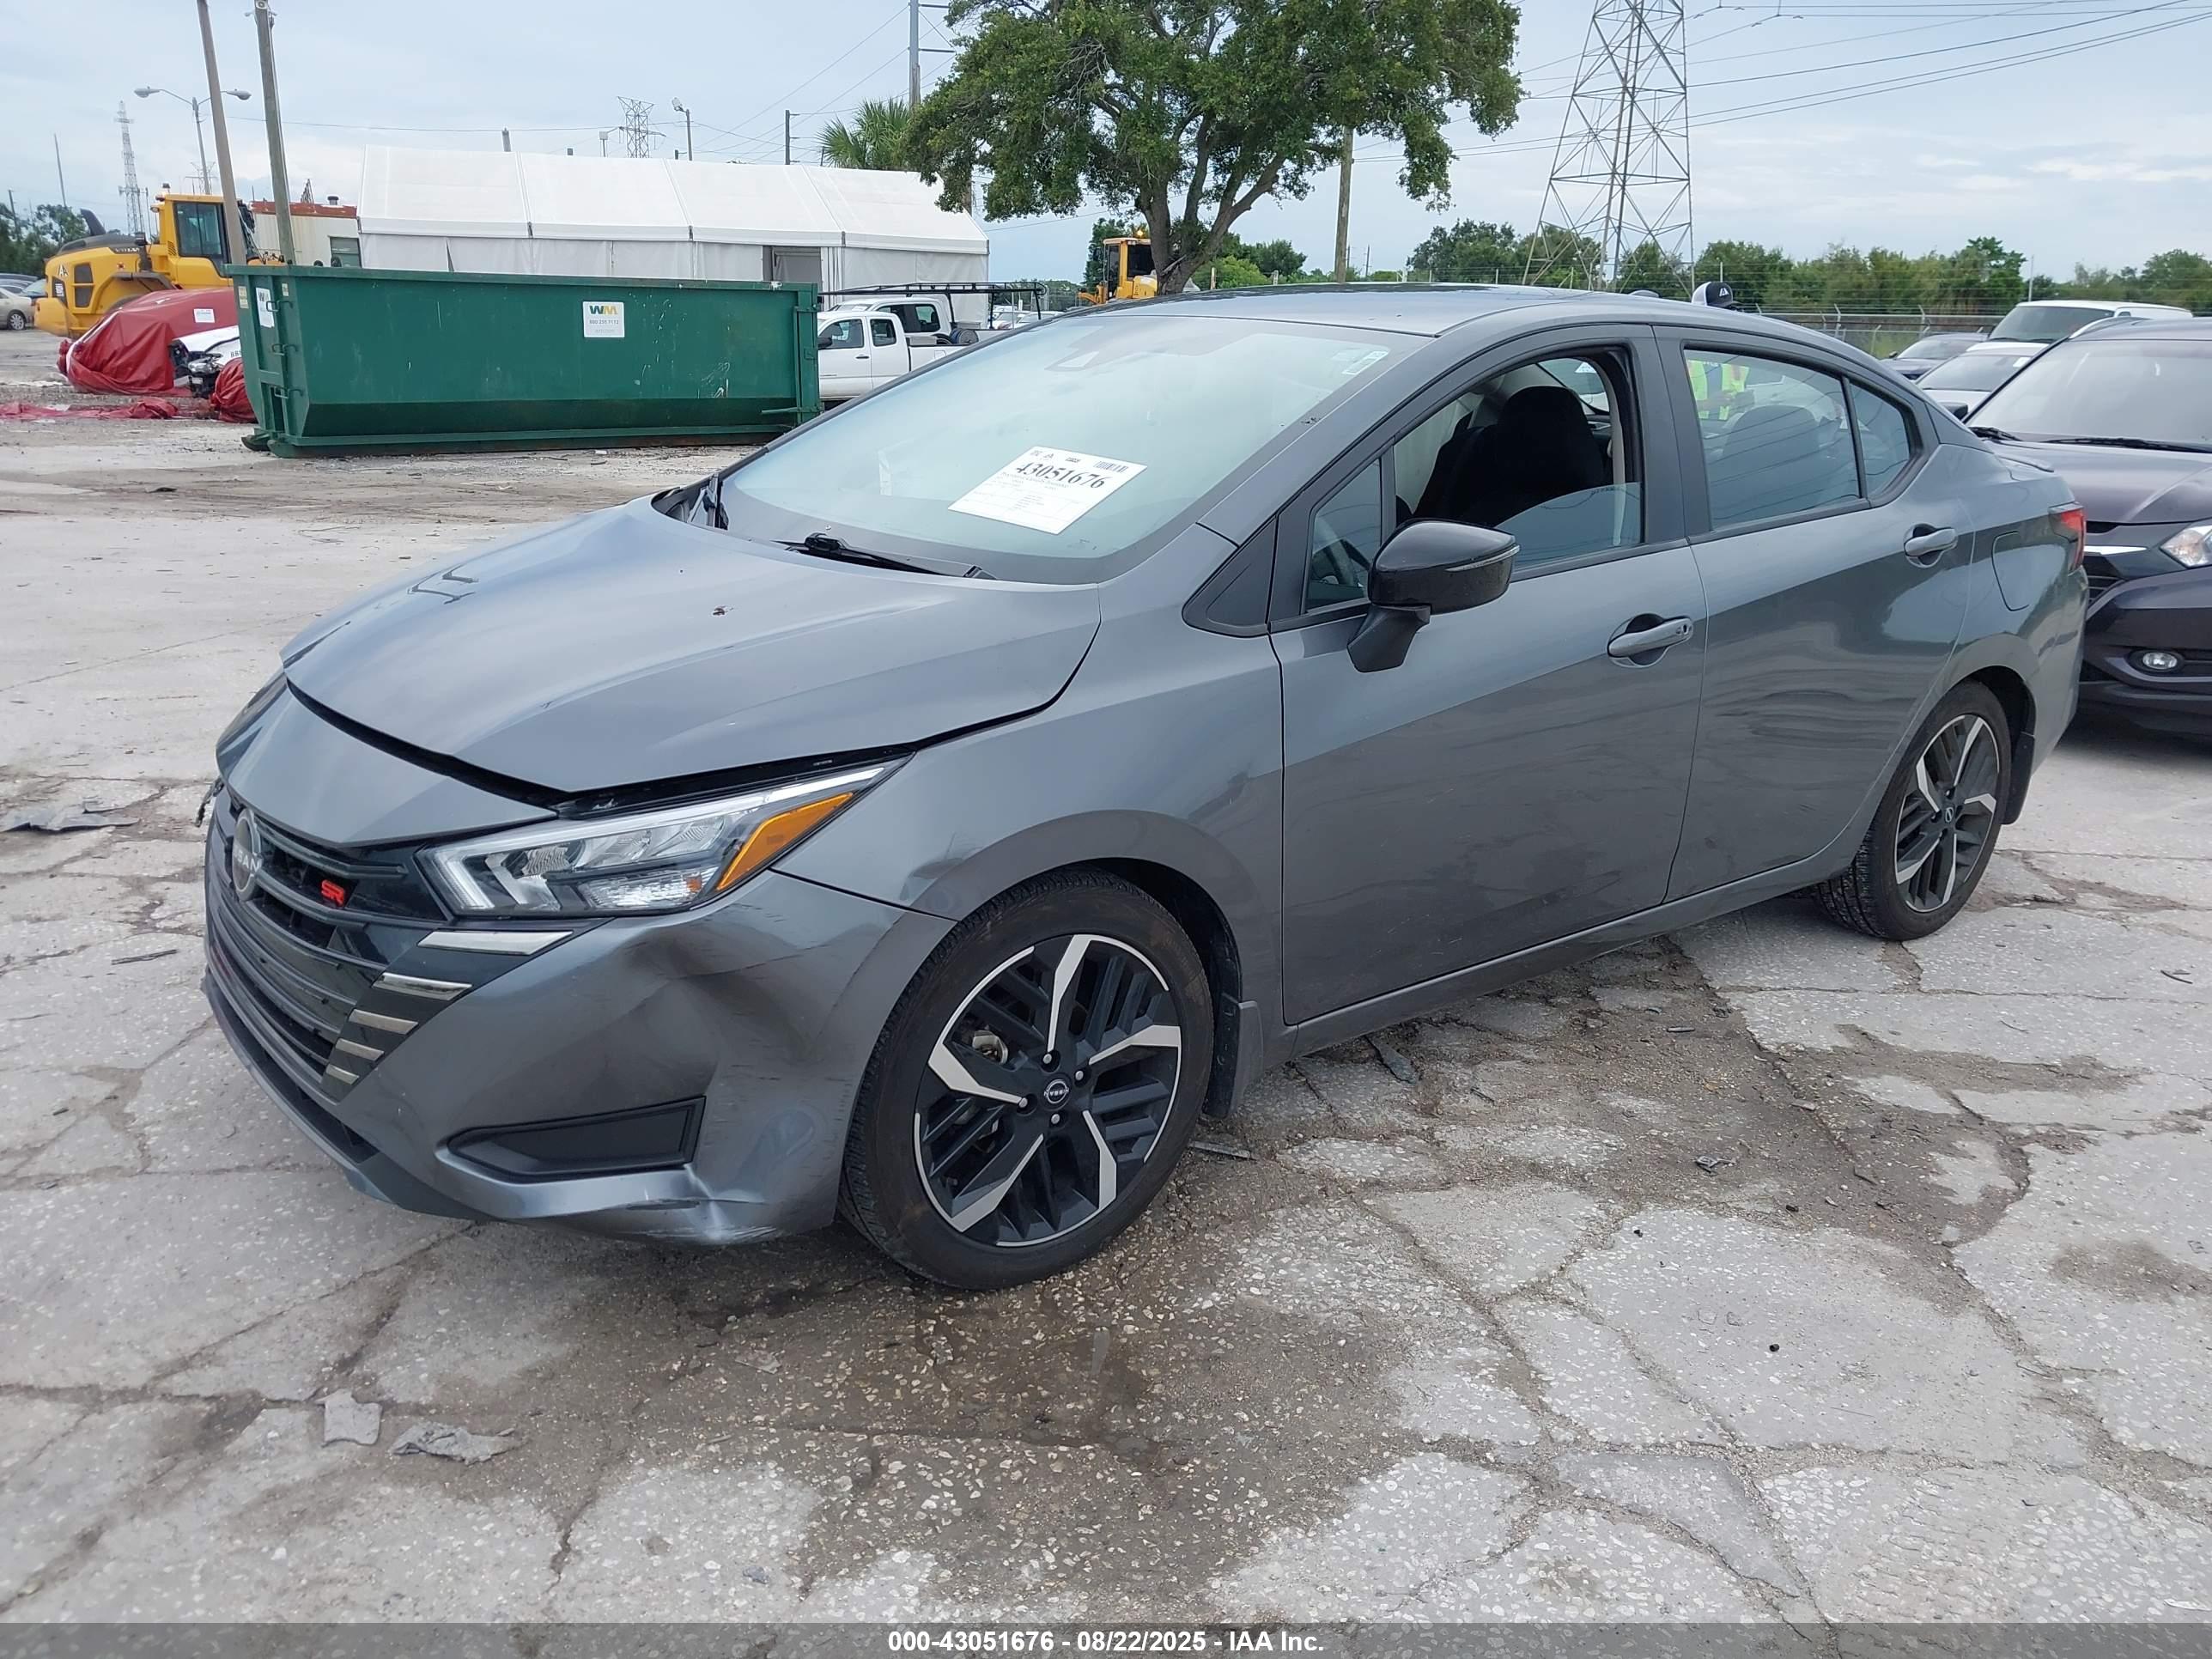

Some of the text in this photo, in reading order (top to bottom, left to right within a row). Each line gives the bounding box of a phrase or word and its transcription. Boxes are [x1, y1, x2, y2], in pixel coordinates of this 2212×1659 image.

[589, 305, 618, 315] WM
[1015, 461, 1113, 489] 43051676
[321, 879, 345, 907] SR
